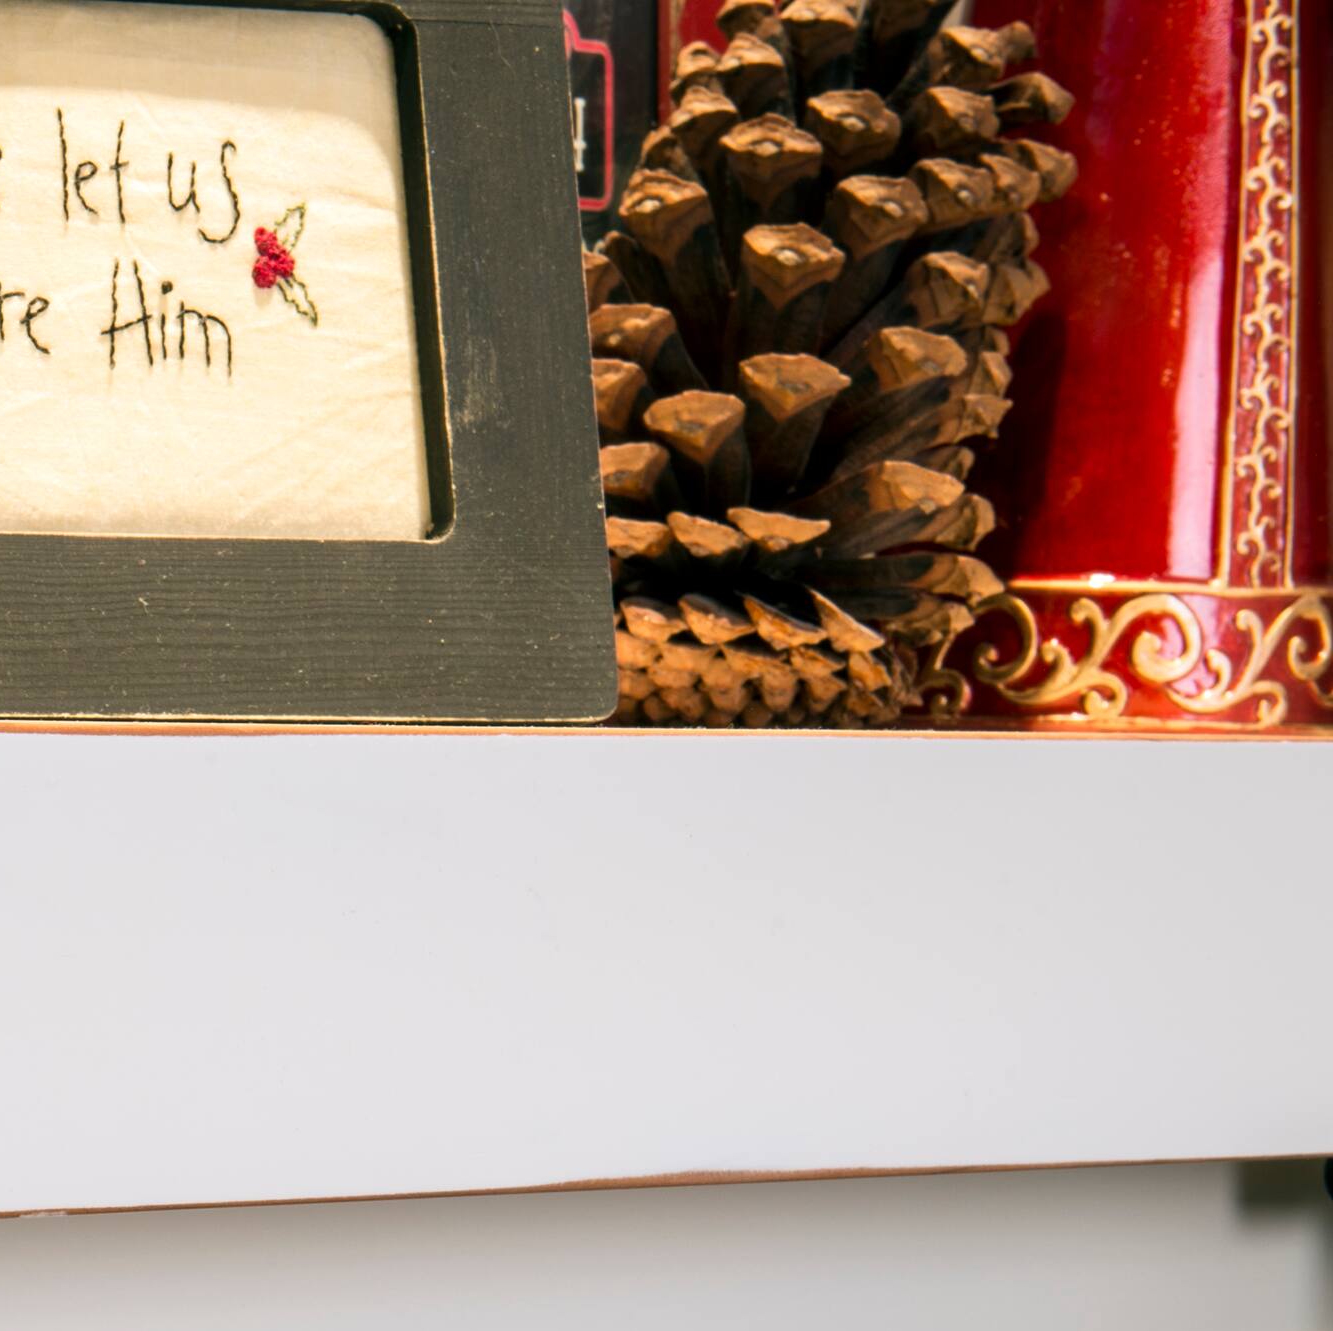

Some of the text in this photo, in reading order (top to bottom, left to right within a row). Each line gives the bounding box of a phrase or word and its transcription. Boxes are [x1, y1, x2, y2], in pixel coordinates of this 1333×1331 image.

[56, 107, 129, 225] let
[167, 139, 241, 244] us
[100, 258, 233, 378] Him
